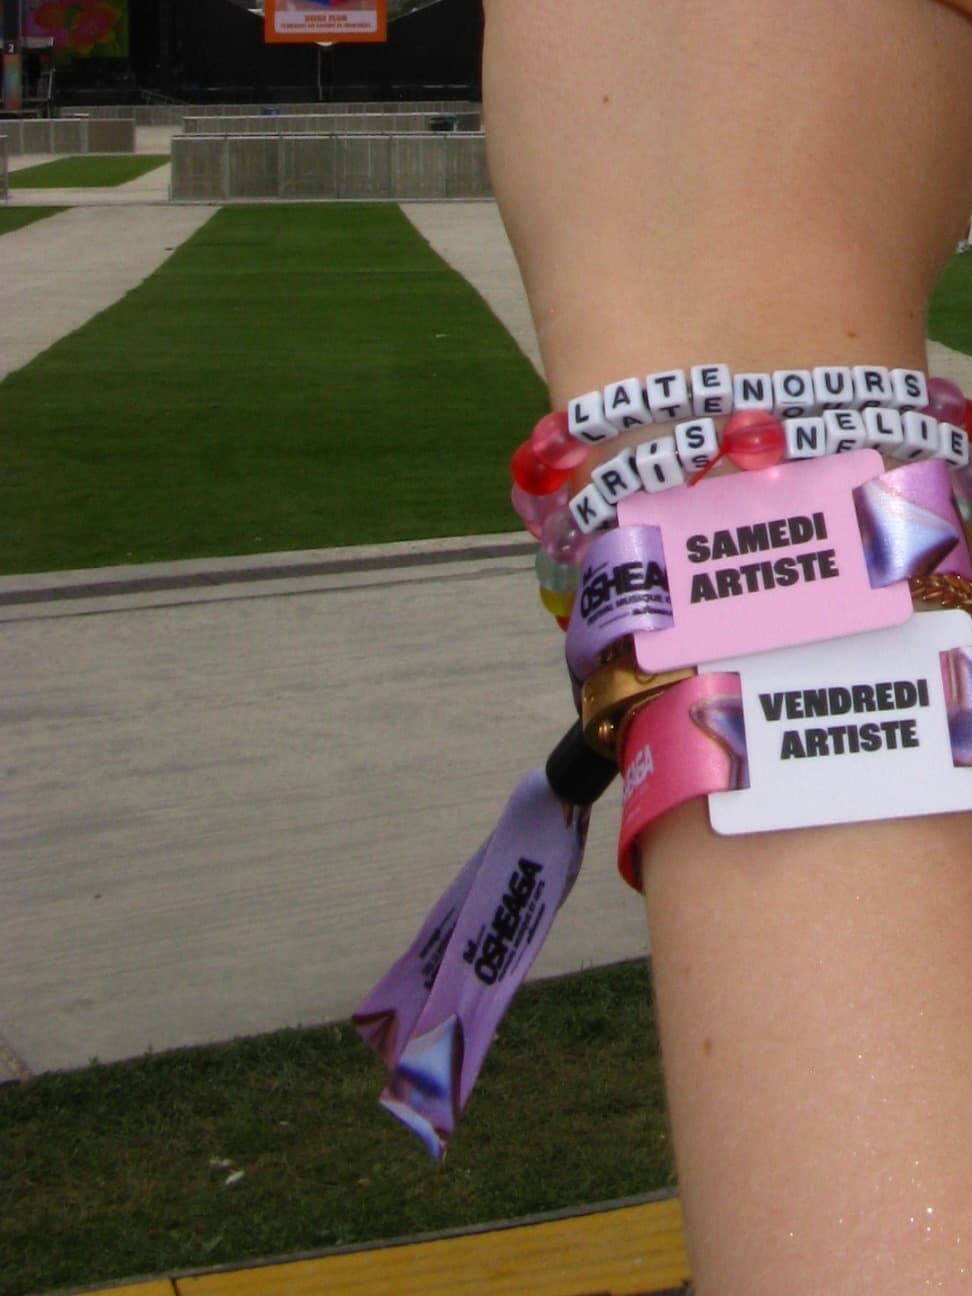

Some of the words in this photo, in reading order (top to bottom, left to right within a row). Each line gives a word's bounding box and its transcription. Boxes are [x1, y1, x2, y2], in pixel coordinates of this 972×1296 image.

[575, 424, 706, 527] KRIS
[795, 411, 964, 458] NELIE
[686, 512, 827, 564] SAMEDI
[690, 548, 839, 604] ARTISTE
[758, 679, 930, 722] VENDREDI
[780, 719, 919, 761] ARTISTE
[473, 856, 544, 987] OSHEAGA
